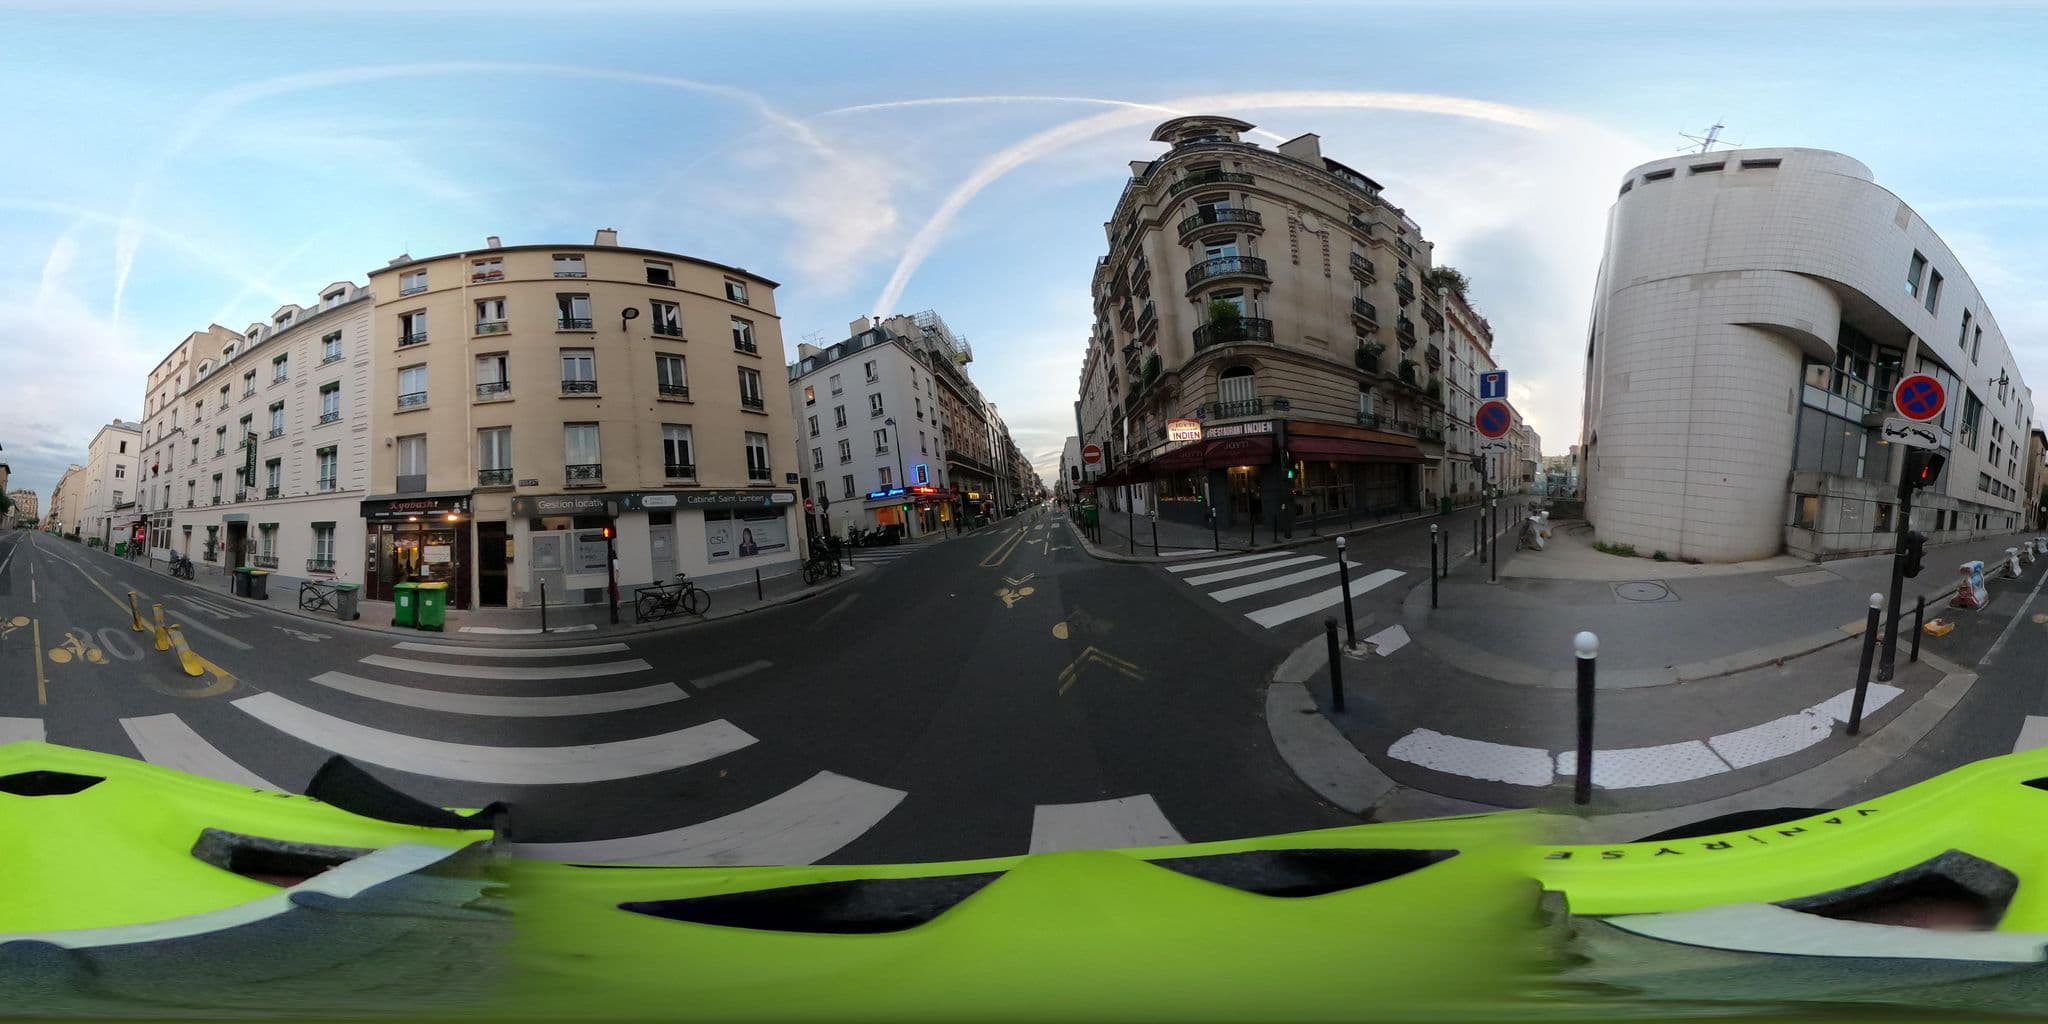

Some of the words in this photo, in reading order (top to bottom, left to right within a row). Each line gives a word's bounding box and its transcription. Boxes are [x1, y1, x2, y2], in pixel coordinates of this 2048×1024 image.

[1244, 421, 1273, 434] INDIEN
[1173, 431, 1200, 441] INDIEN
[687, 495, 716, 504] Cabinet
[538, 500, 574, 510] Gestion
